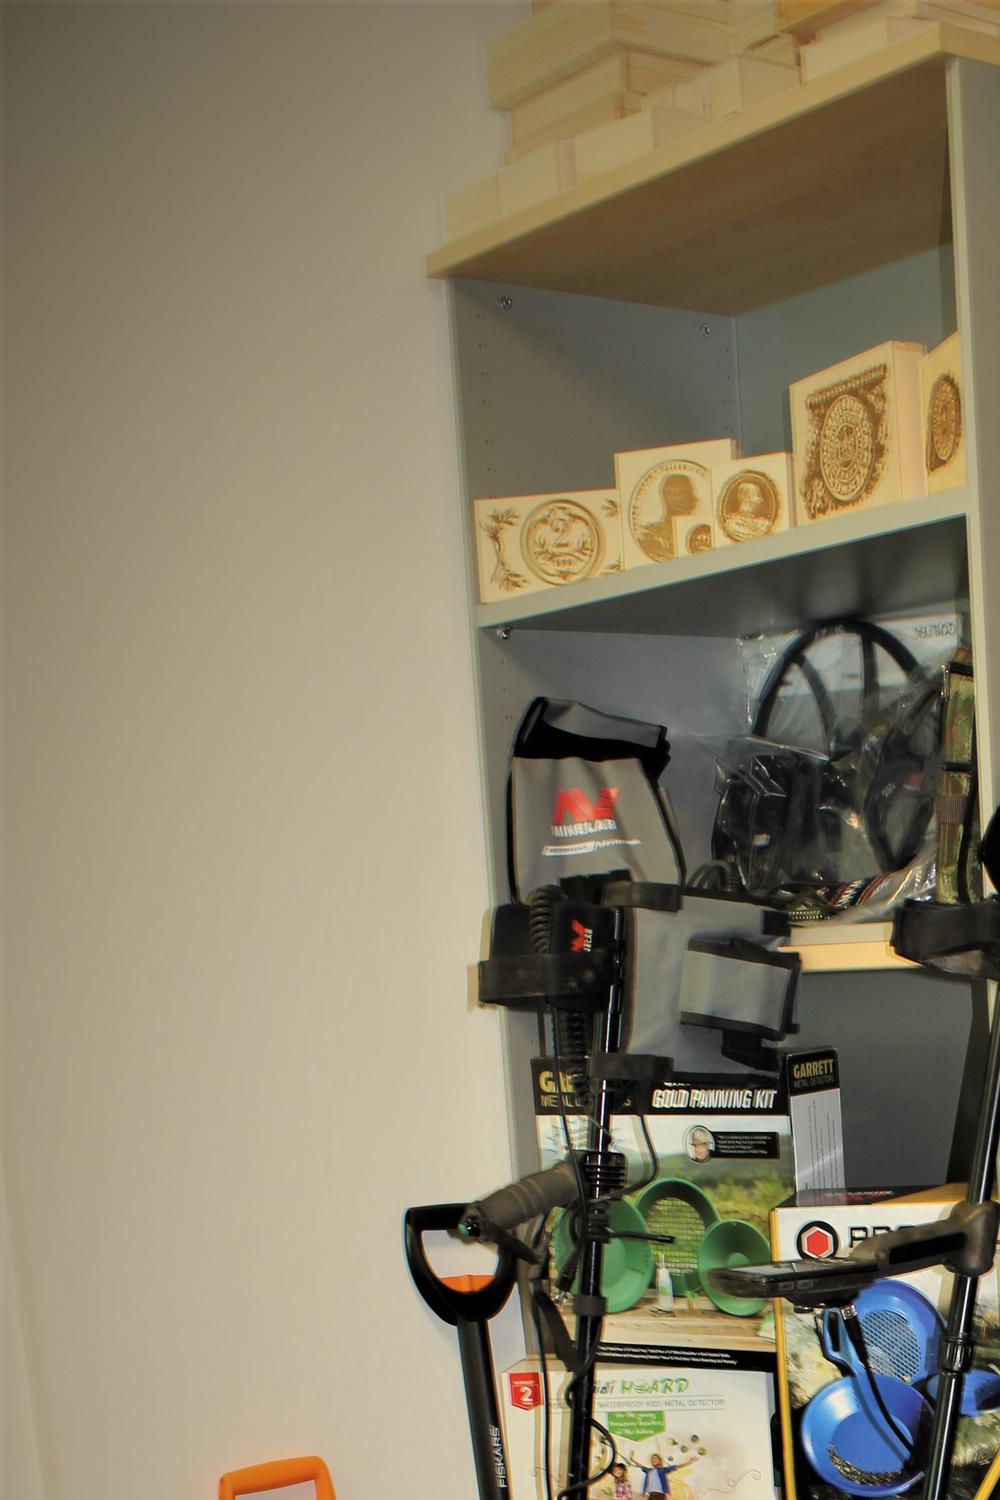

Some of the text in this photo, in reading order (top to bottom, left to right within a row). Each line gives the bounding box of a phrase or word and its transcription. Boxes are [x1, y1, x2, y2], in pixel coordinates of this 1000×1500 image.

[793, 1058, 834, 1079] GARRETT
[652, 1088, 778, 1110] GOLD PANNING KIT
[519, 1386, 533, 1402] 2
[646, 1399, 663, 1409] KIDS
[664, 1399, 686, 1409] METAL
[489, 1424, 507, 1488] FISKARS
